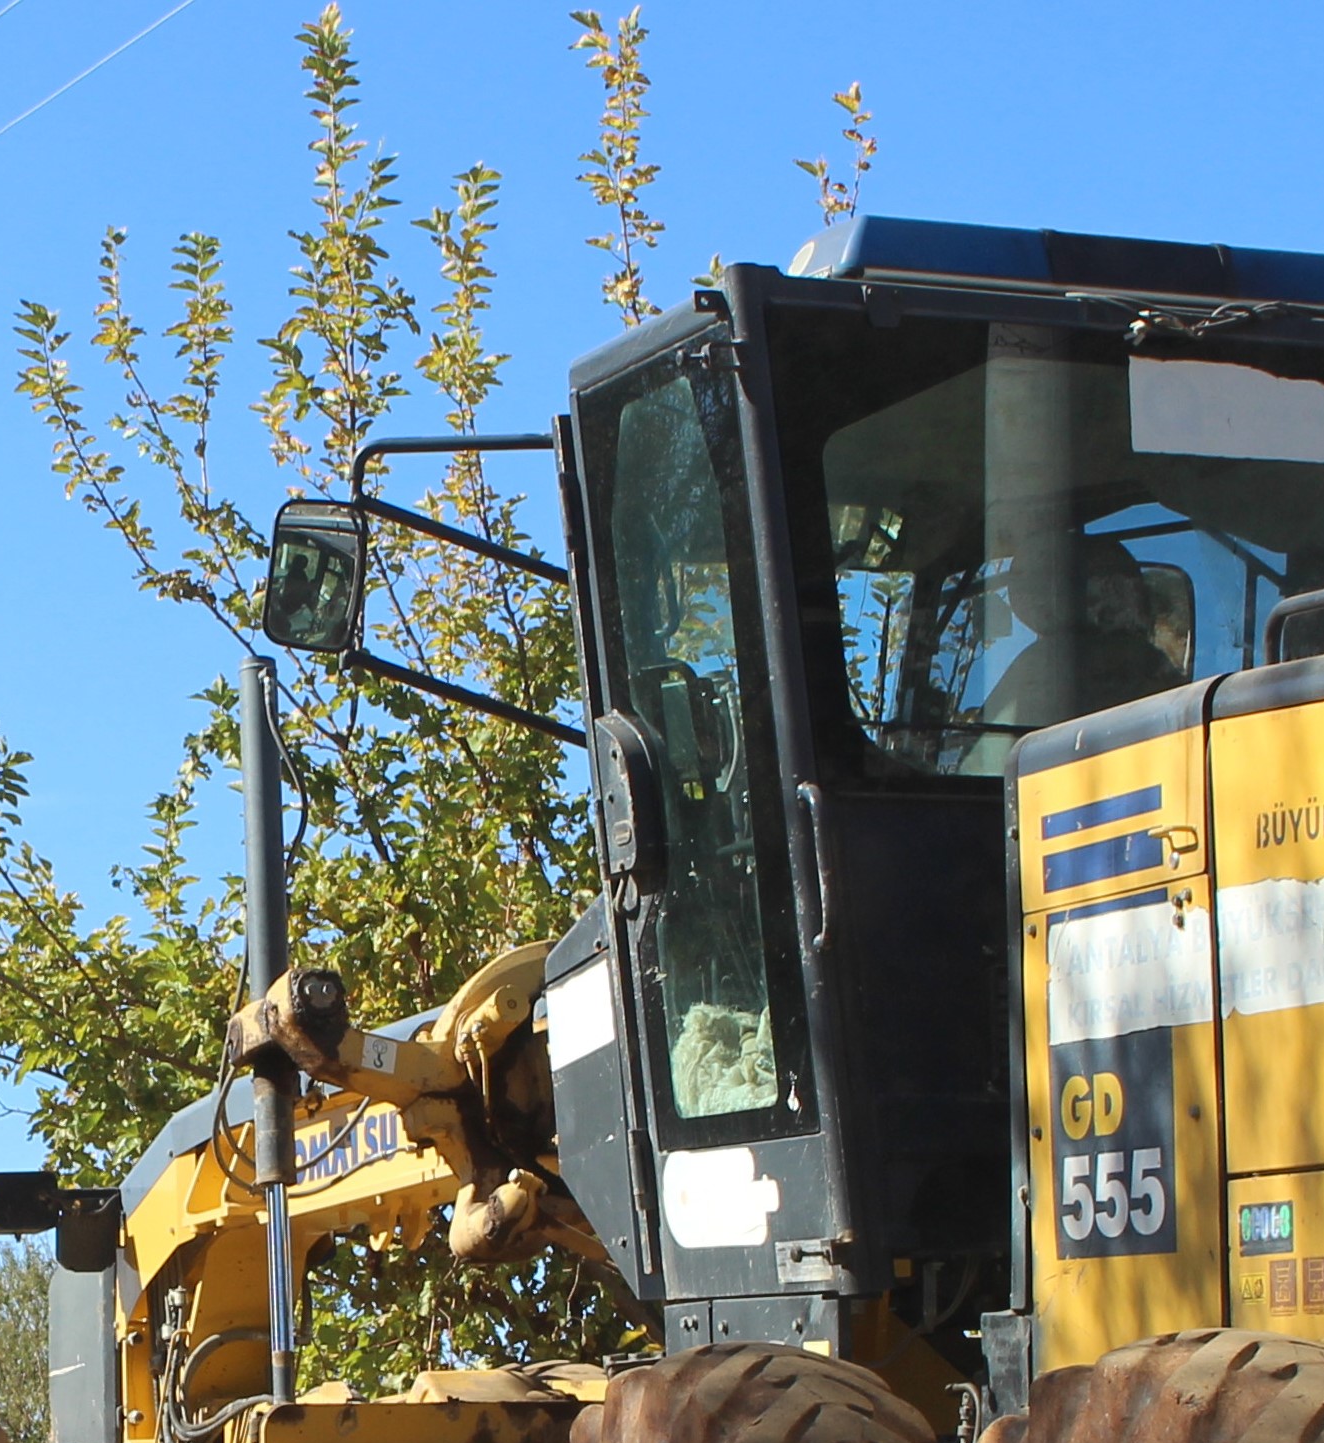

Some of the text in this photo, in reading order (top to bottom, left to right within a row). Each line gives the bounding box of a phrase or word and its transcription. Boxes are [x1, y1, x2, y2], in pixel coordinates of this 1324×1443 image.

[1061, 1072, 1123, 1140] GD
[295, 1110, 398, 1185] OMATSU
[1062, 1147, 1165, 1240] 555
